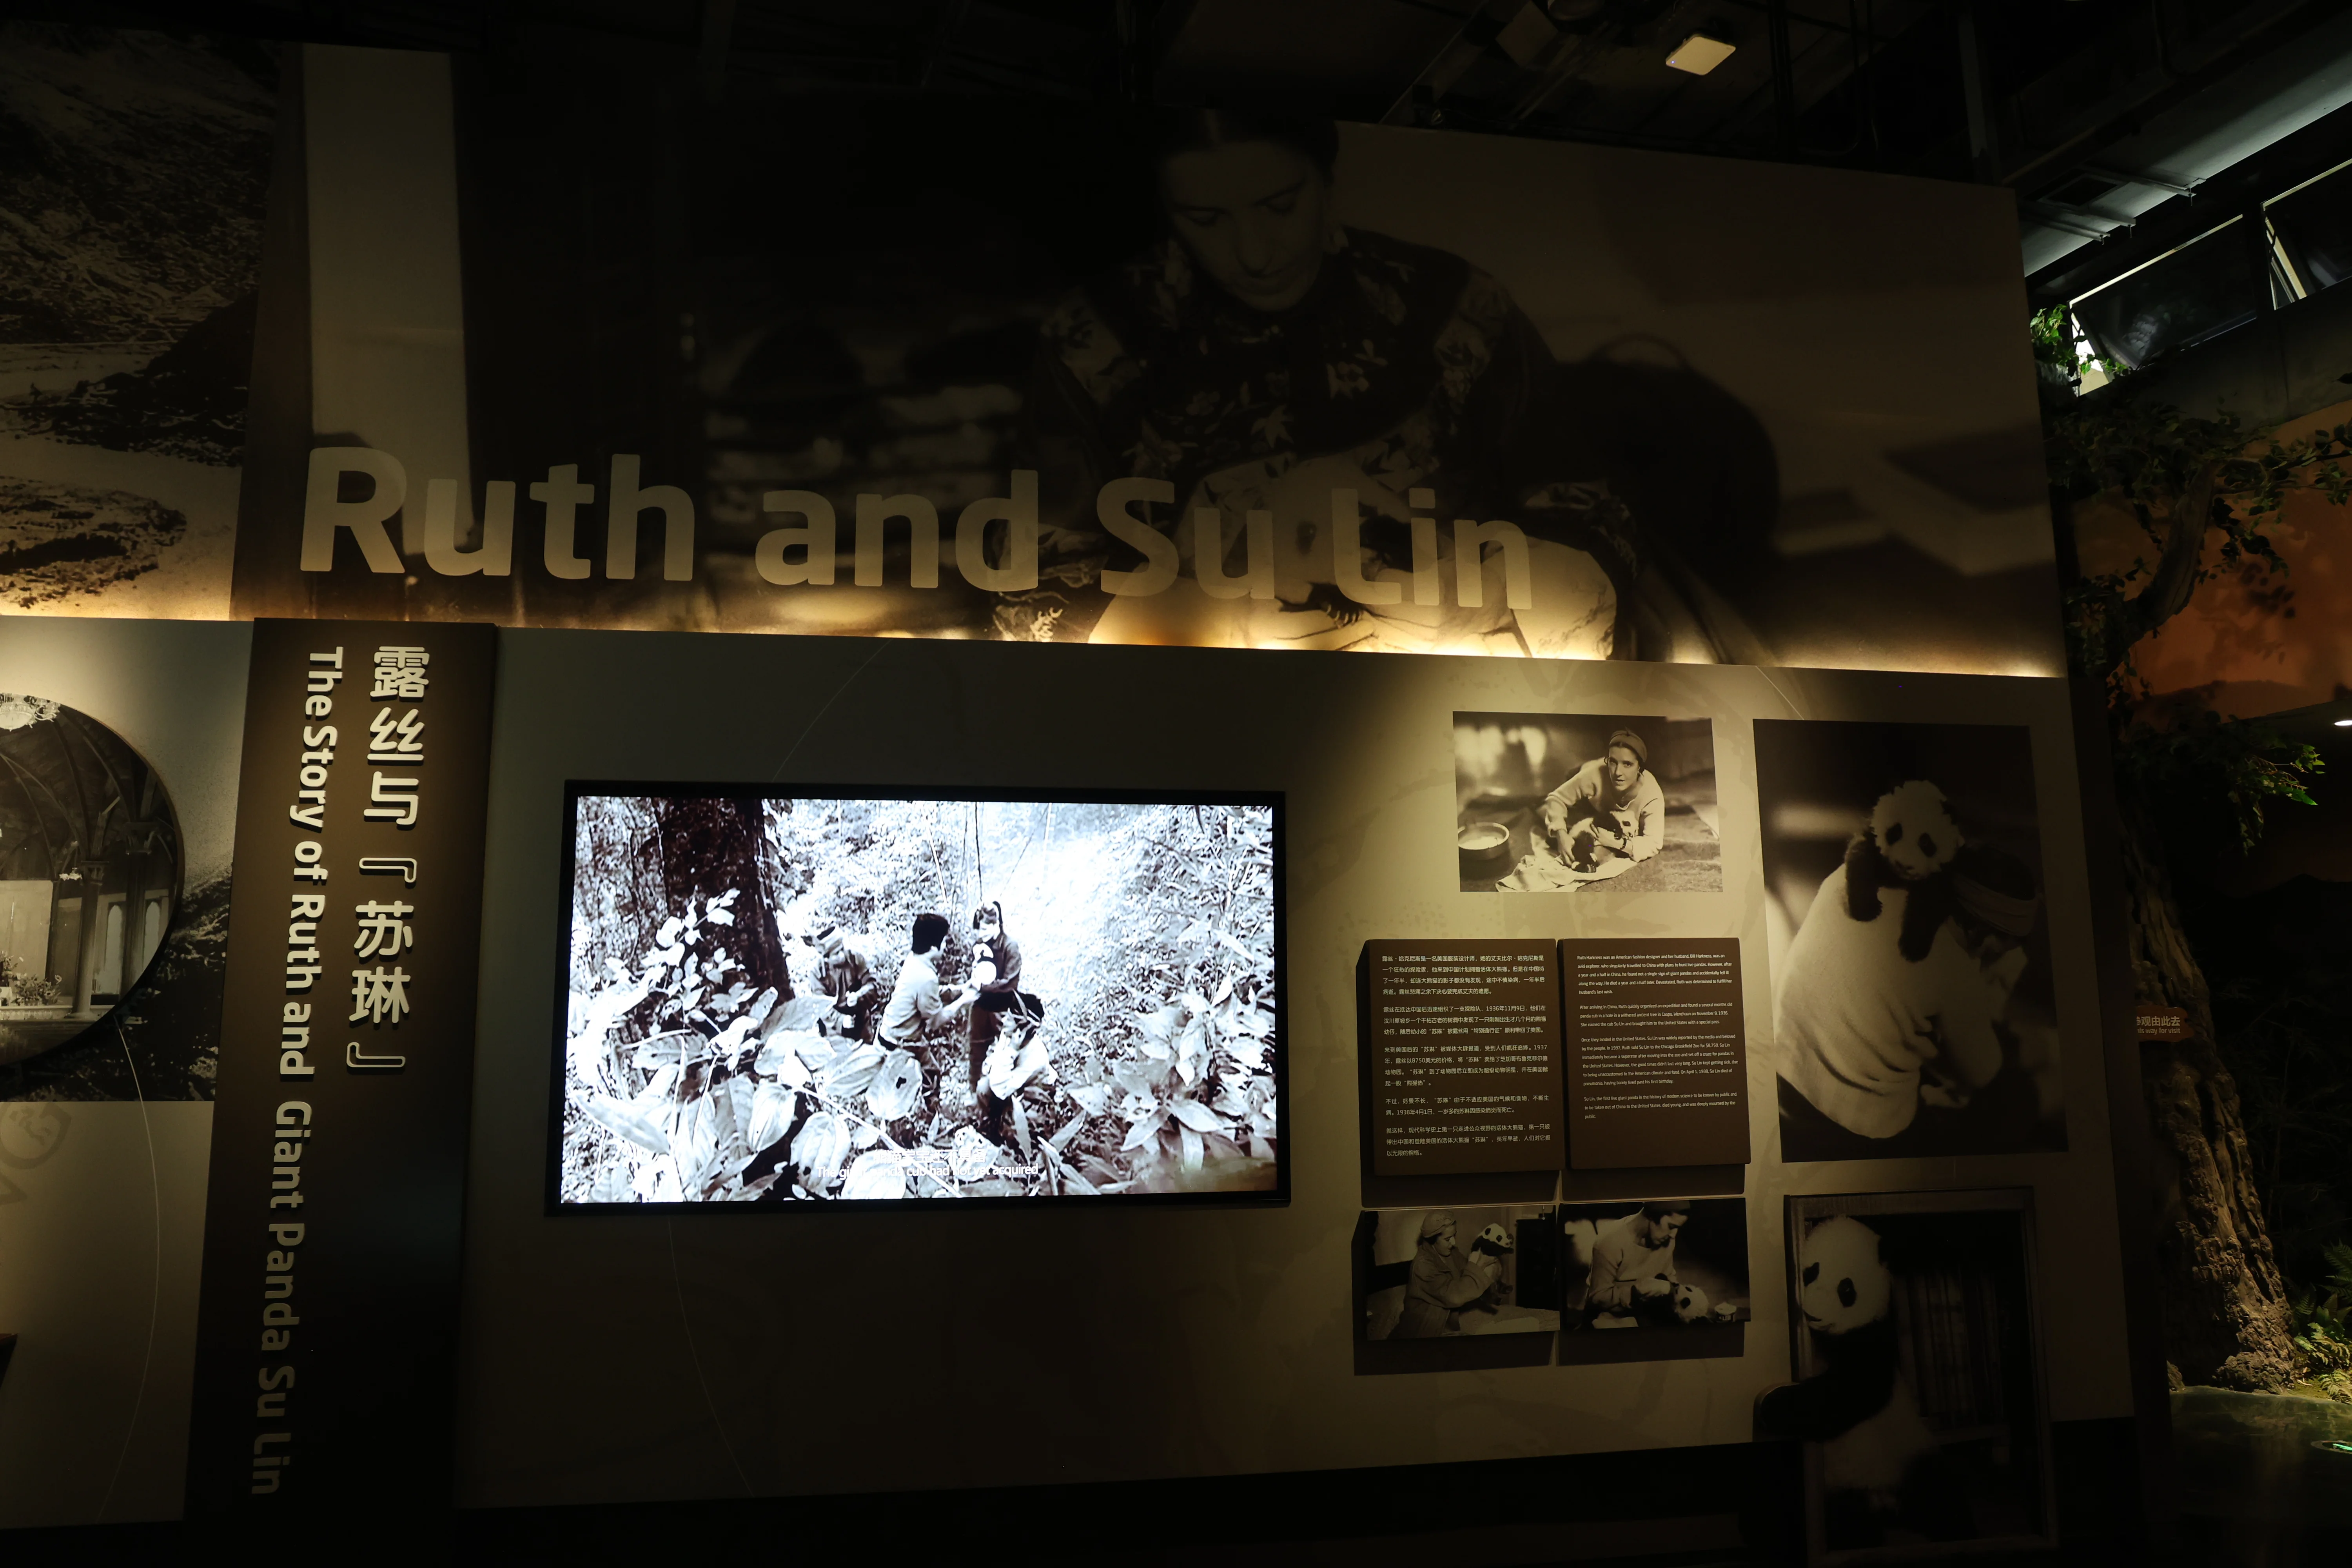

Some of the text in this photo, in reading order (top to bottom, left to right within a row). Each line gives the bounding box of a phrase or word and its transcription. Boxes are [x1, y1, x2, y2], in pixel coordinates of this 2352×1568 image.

[300, 446, 1532, 610] Ruth and Su Lin
[251, 646, 343, 1495] The Story of Ruth and Giant Panda Su Lin
[816, 1165, 838, 1178] The
[929, 1164, 950, 1176] had
[973, 1165, 991, 1178] yet
[993, 1163, 1038, 1178] acquired
